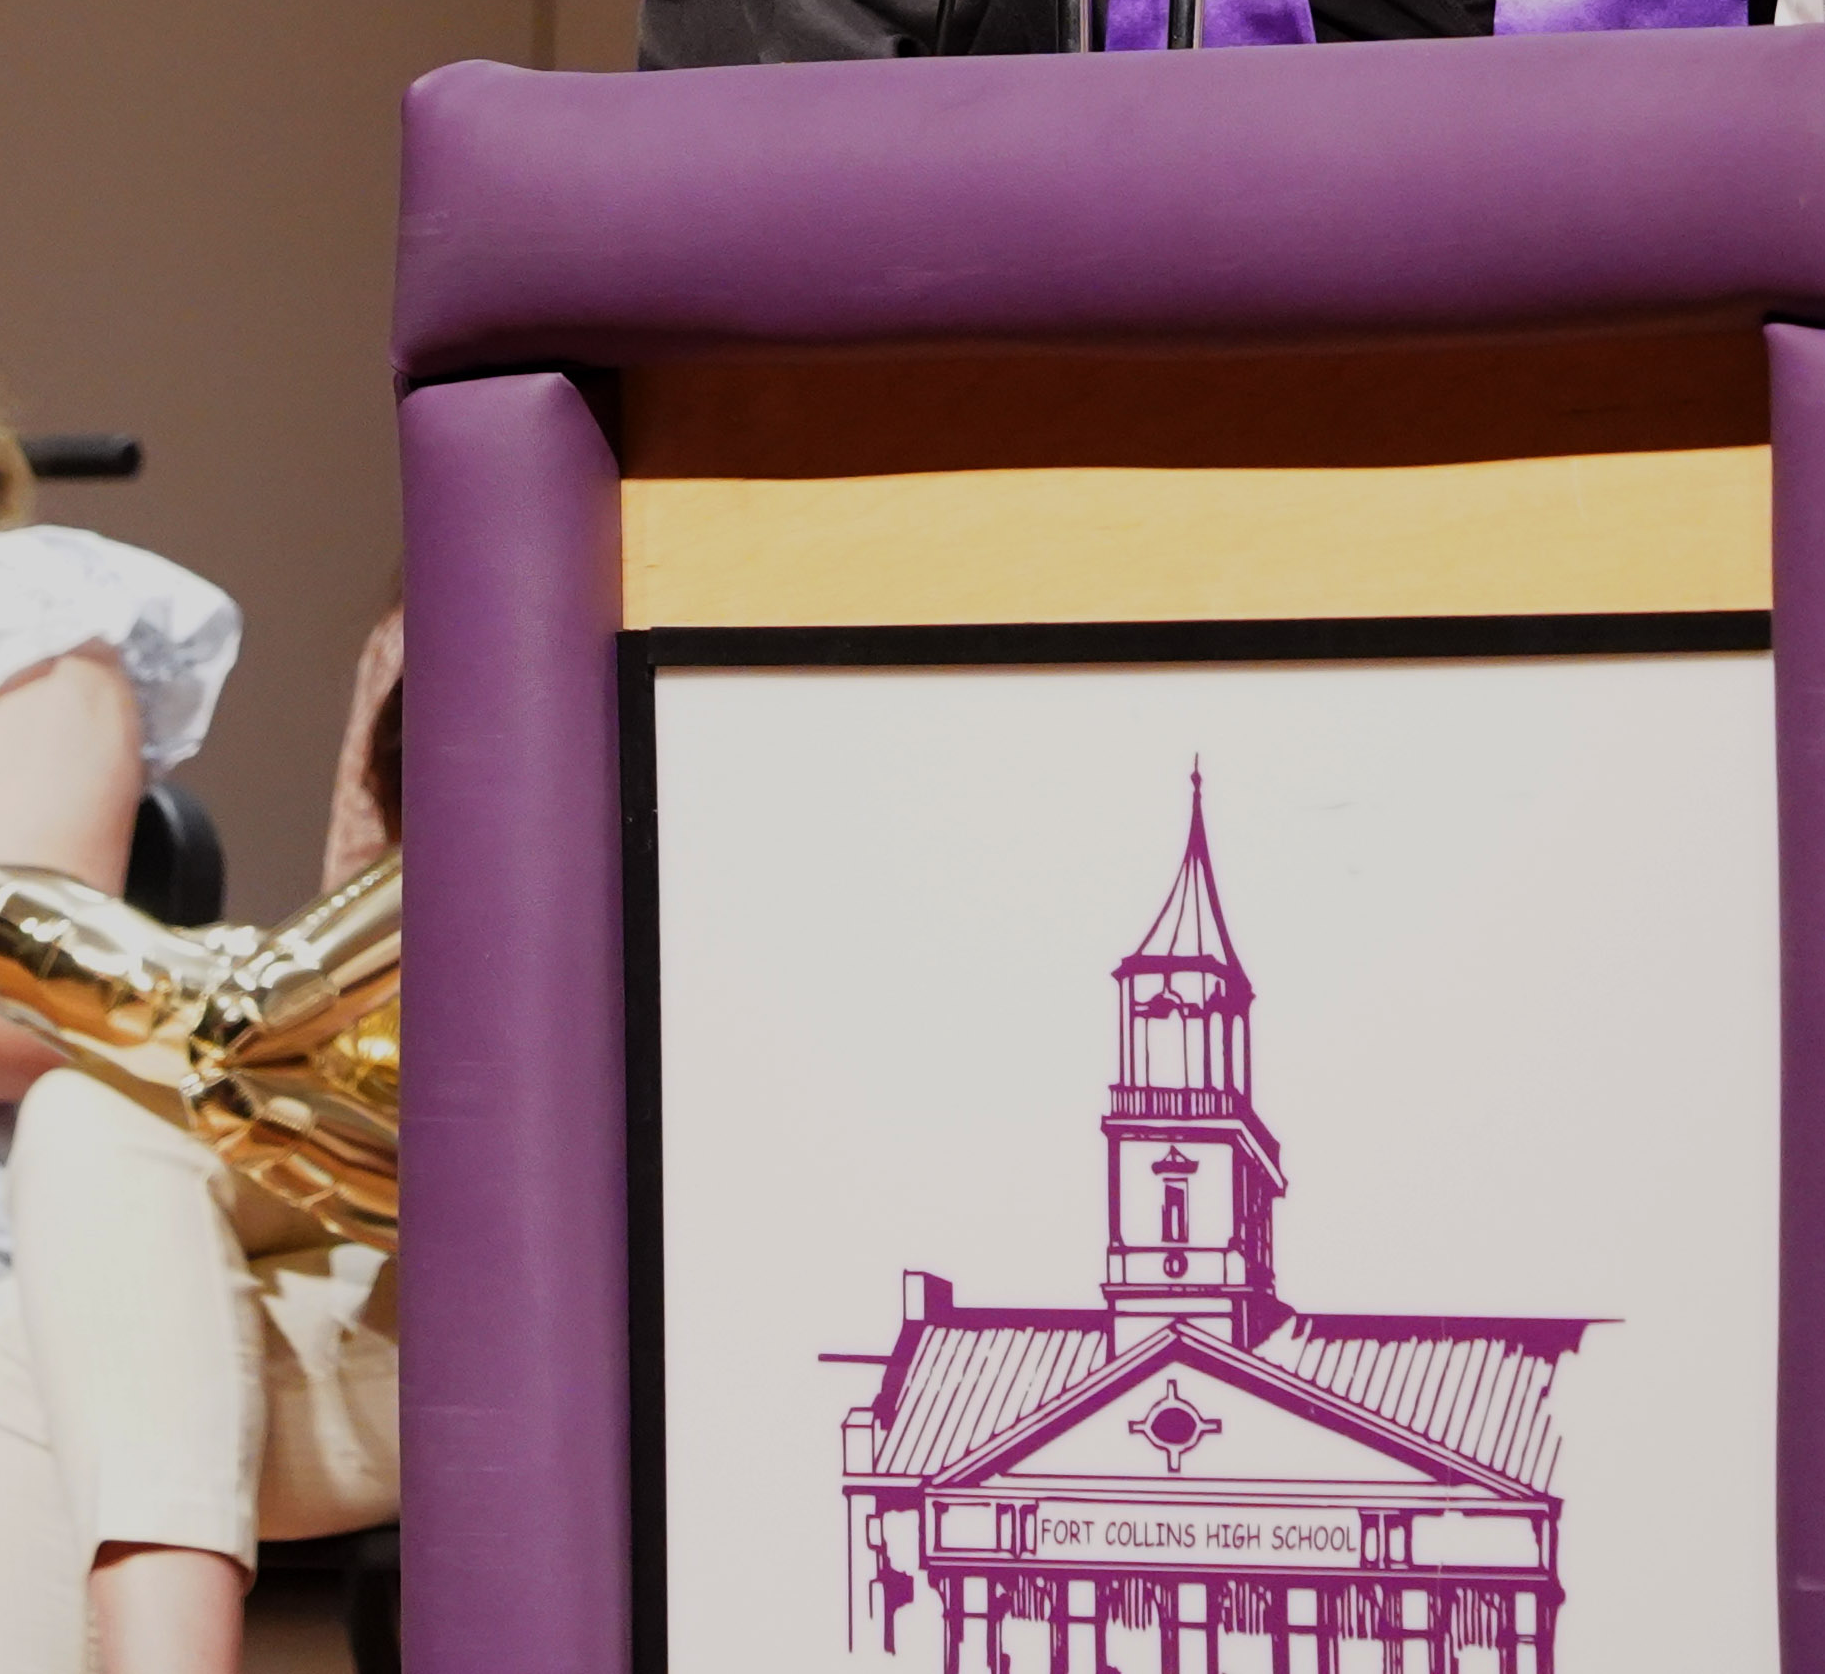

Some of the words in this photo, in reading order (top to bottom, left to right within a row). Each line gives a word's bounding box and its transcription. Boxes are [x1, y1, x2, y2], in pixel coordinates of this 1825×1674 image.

[1041, 1519, 1096, 1546] FORT
[1104, 1521, 1197, 1550] COLLINS
[1205, 1523, 1261, 1550] HIGH
[1271, 1525, 1358, 1552] SCHOOL
